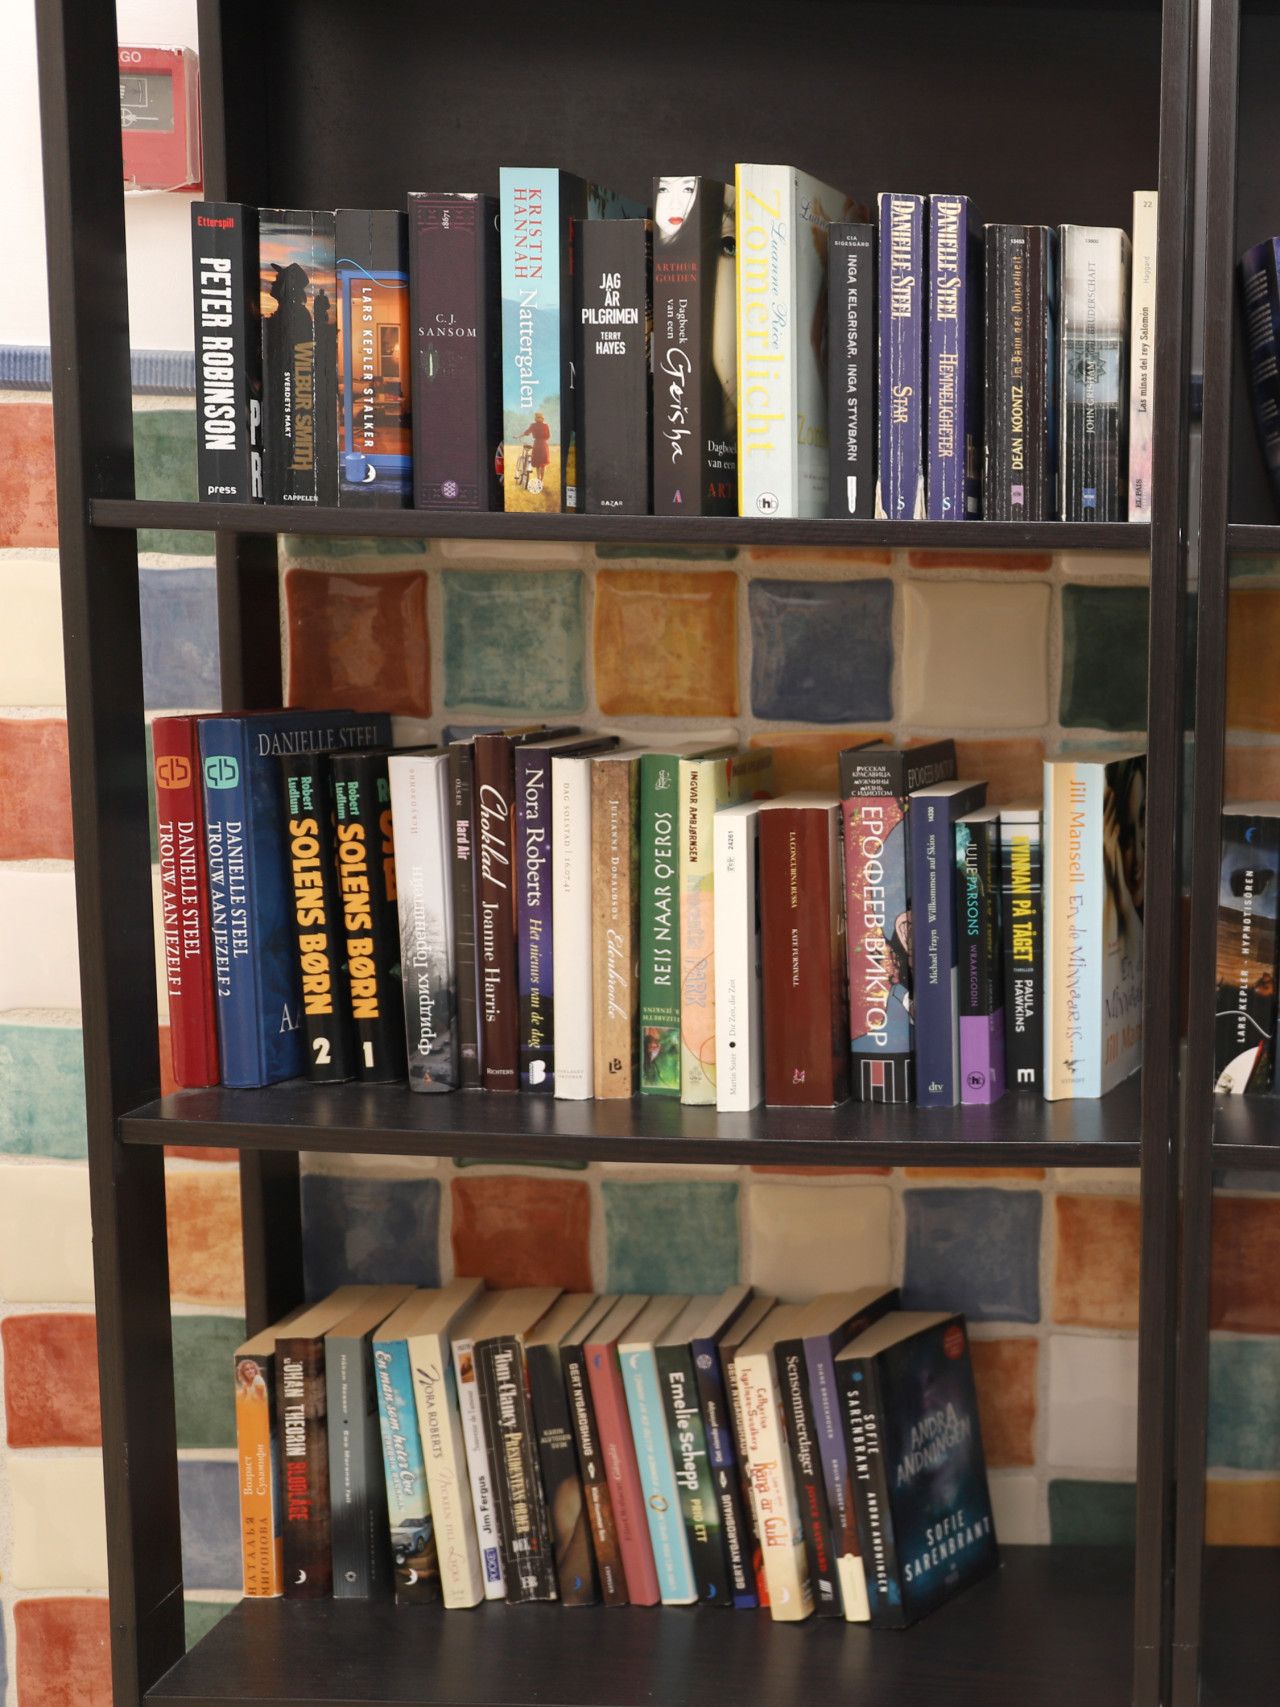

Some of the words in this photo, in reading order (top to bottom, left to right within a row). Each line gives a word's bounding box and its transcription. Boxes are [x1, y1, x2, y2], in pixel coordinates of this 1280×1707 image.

[197, 215, 235, 229] Etterspill
[514, 188, 528, 279] HANNAH
[528, 188, 543, 280] KRISTIN
[891, 201, 915, 275] DANIELLE
[937, 202, 961, 275] DANIELLE
[599, 273, 621, 290] JAG
[847, 254, 858, 284] INGA
[200, 257, 232, 327] PETER
[361, 287, 372, 321] LARS
[605, 287, 621, 307] ÄR
[667, 299, 675, 318] van
[891, 277, 915, 321] STEEL
[936, 277, 961, 321] STEEL
[418, 325, 478, 337] SANSOM
[582, 308, 639, 325] PILGRIMEN
[667, 321, 675, 340] een
[744, 188, 786, 457] Zomerlicht
[362, 329, 374, 380] KEPLER
[515, 288, 538, 410] Nattergalen
[596, 341, 626, 355] HAYES
[1140, 357, 1148, 370] del
[202, 336, 237, 452] ROBINSON
[283, 372, 291, 412] SVERDETS
[847, 363, 858, 393] INGA
[1140, 372, 1148, 396] minas
[284, 413, 292, 438] MAKT
[362, 387, 375, 448] STALKER
[894, 386, 912, 424] STAR
[1011, 386, 1024, 431] KOONTZ
[1086, 413, 1096, 435] JOHN
[1140, 399, 1148, 413] Las
[847, 396, 858, 461] STYVBARN
[1011, 445, 1023, 471] DEAN
[207, 484, 237, 500] press
[288, 777, 300, 816] Ludlum
[300, 776, 313, 812] Robert
[336, 782, 346, 820] Ludlum
[347, 781, 360, 816] Robert
[525, 768, 544, 821] Nora
[690, 771, 698, 802] INGVAR
[1069, 780, 1086, 804] Jill
[160, 821, 176, 884] TROUW
[207, 821, 224, 885] TROUW
[457, 820, 470, 846] Hard
[478, 784, 508, 889] Choklad
[689, 805, 698, 863] AMBJØRNSEN
[1069, 813, 1086, 885] Mansell
[178, 821, 198, 904] DANIELLE
[225, 821, 245, 903] DANIELLE
[289, 818, 327, 927] SOLENS
[457, 848, 470, 861] Air
[526, 827, 546, 908] Roberts
[859, 806, 886, 931] ЕРОФЕЕВ
[964, 842, 977, 878] JULIE
[338, 822, 373, 932] SOLENS
[164, 887, 178, 928] AAN
[211, 888, 225, 929] AAN
[653, 885, 671, 942] NAAR
[967, 878, 978, 936] PARSONS
[1012, 900, 1036, 919] PÅ
[182, 905, 201, 959] STEEL
[229, 905, 248, 959] STEEL
[482, 901, 500, 962] Joanne
[929, 929, 941, 951] Frayn
[1012, 921, 1037, 961] TÅGET
[300, 933, 333, 1015] BØRN
[348, 937, 380, 1019] BØRN
[653, 948, 671, 986] REIS
[929, 953, 940, 984] Michael
[484, 967, 501, 1023] Harris
[863, 931, 888, 1047] ВИКТОР
[1014, 980, 1025, 1033] HAWKINS
[1024, 979, 1033, 1017] PAULA
[1239, 969, 1249, 1011] KEPLER
[415, 973, 437, 1055] Фридрих
[1235, 1014, 1247, 1043] LARS
[312, 1037, 332, 1065] 2
[362, 1041, 375, 1068] 1
[494, 1349, 514, 1378] Tom
[569, 1362, 582, 1386] GERT
[669, 1371, 699, 1430] Emelie
[786, 1356, 813, 1476] Sensommerdager
[284, 1404, 307, 1457] THEORIN
[847, 1390, 869, 1481] SARENBRANT
[863, 1414, 879, 1455] SOFIE
[678, 1428, 706, 1491] Schepp
[479, 1475, 490, 1512] Fergus
[867, 1492, 880, 1527] ANDRA
[482, 1513, 492, 1534] Jim
[926, 1509, 965, 1546] SOFIE
[872, 1530, 888, 1593] ANDNINGEN
[904, 1516, 991, 1581] SARENBRANT
[734, 1564, 746, 1589] GERT
